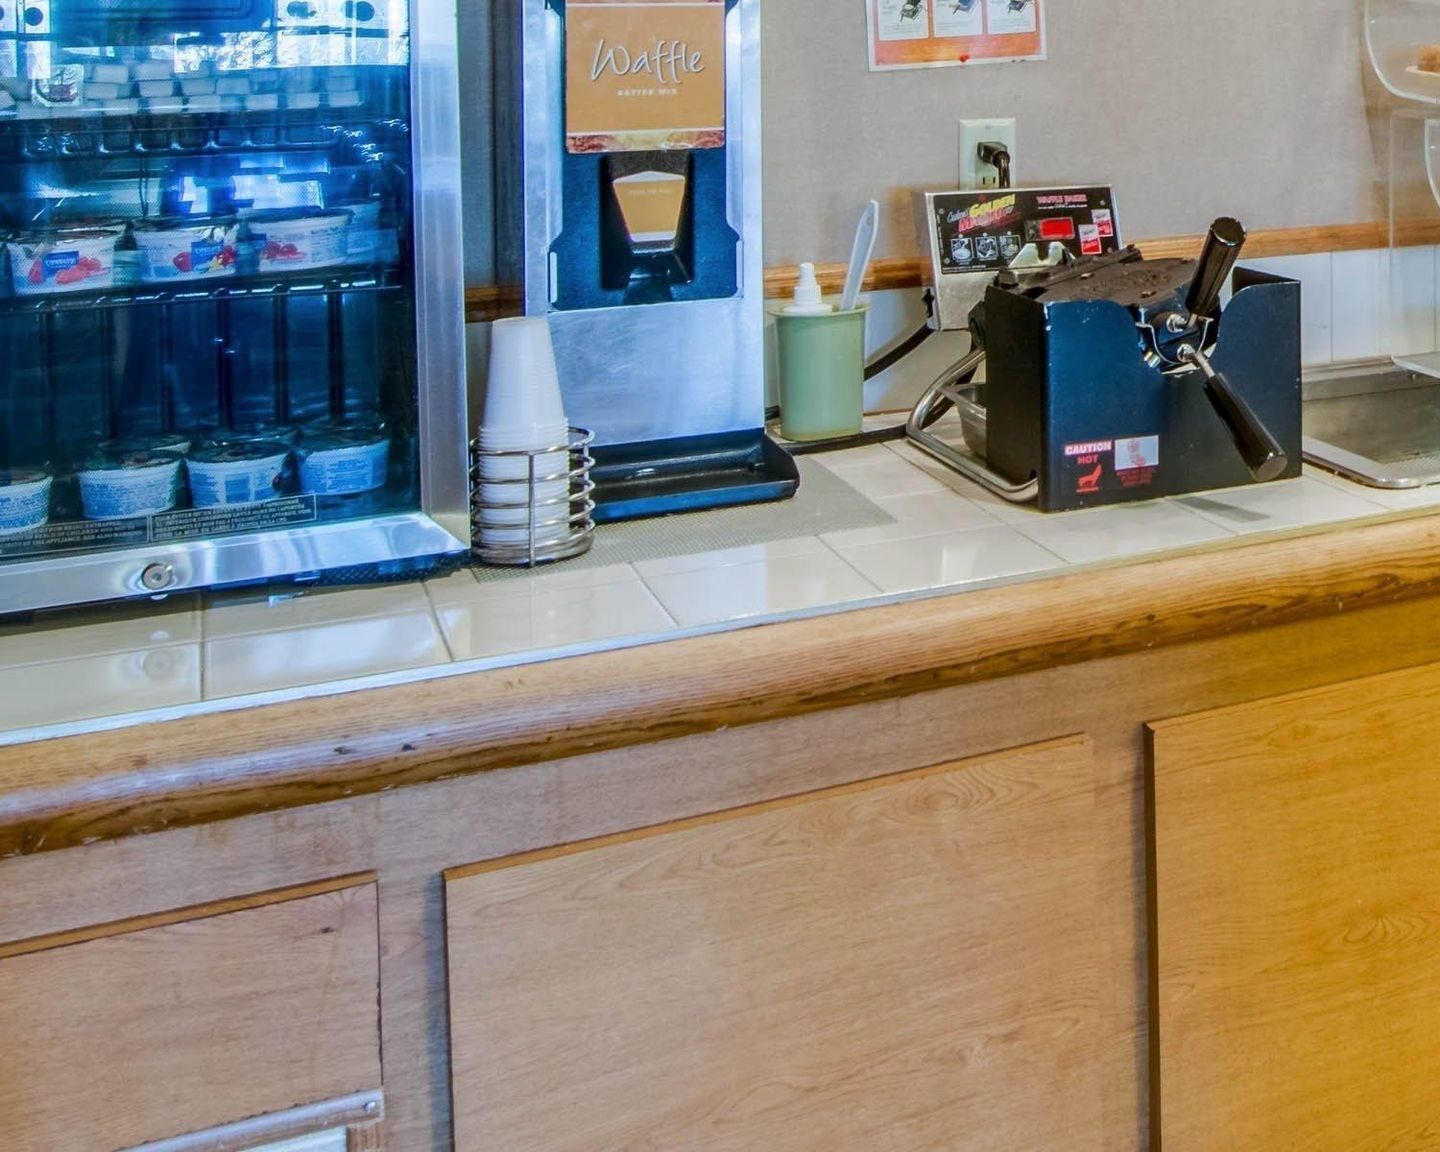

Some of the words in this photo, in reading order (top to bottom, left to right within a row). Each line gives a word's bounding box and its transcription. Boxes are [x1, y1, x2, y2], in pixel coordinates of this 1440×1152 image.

[590, 38, 705, 84] Waffle
[1064, 440, 1113, 456] CAUTION
[1077, 454, 1099, 465] HOT
